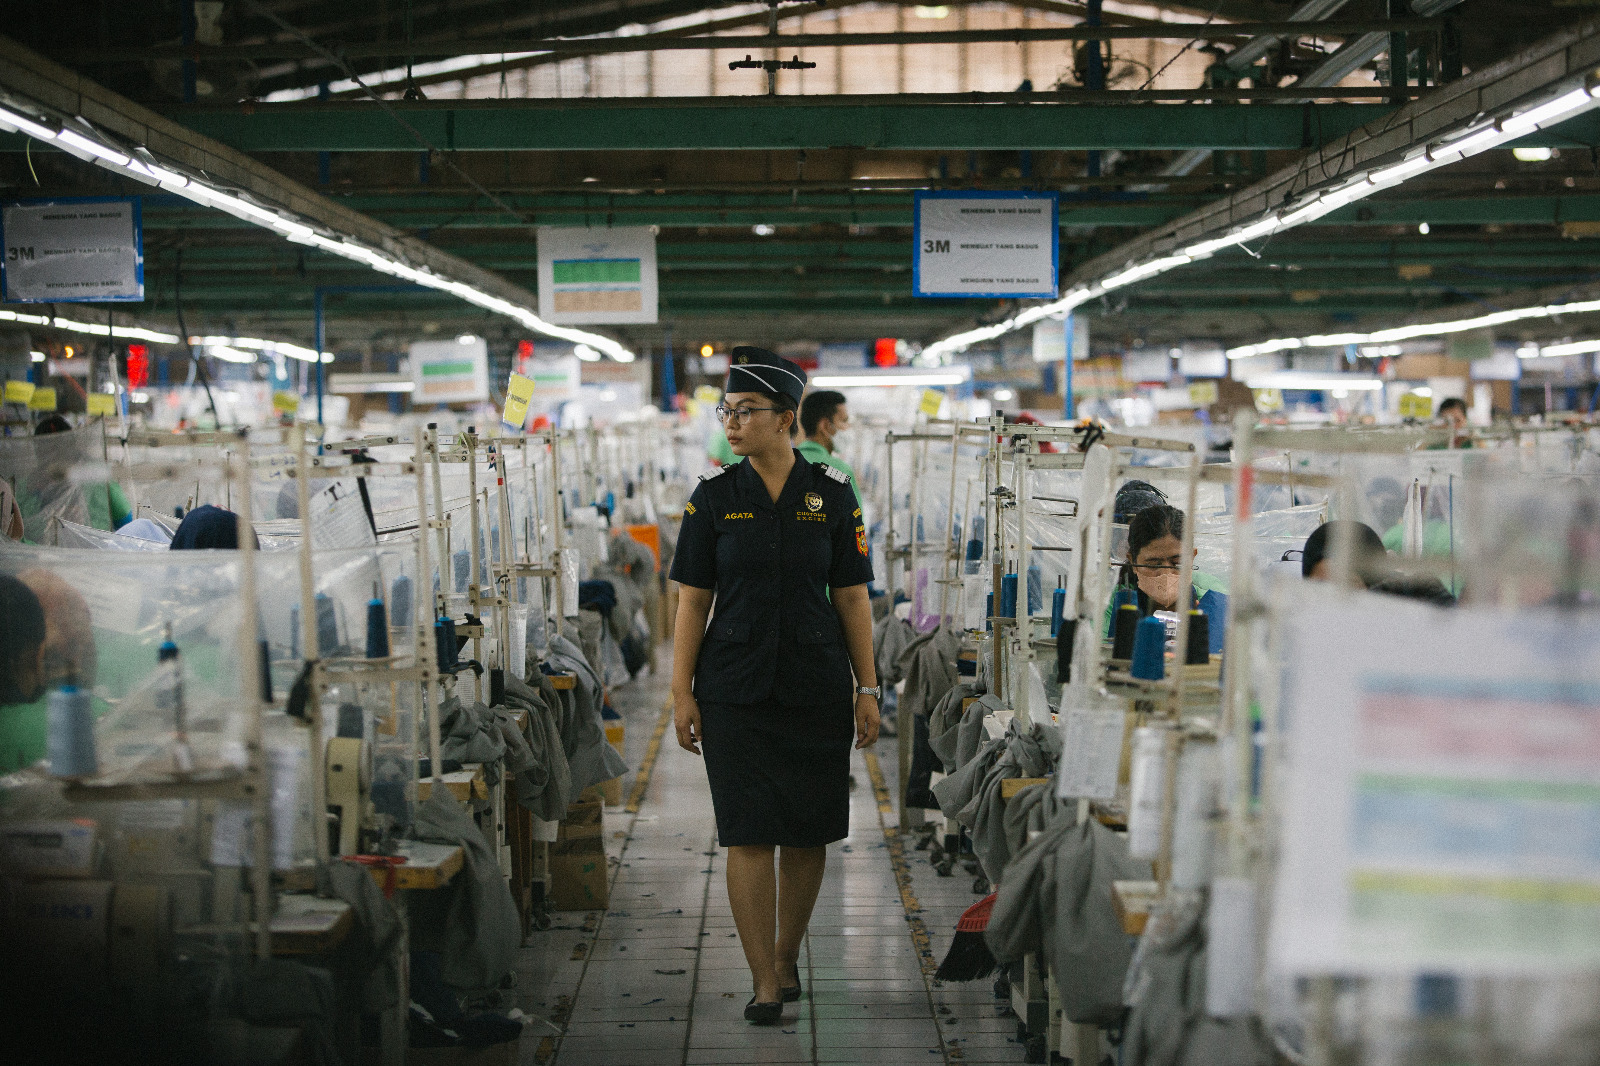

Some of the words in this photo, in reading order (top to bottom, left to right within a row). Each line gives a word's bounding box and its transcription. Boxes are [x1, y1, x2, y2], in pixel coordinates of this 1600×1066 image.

[8, 246, 35, 261] 3M
[924, 240, 951, 254] 3M
[724, 512, 754, 520] AGATA
